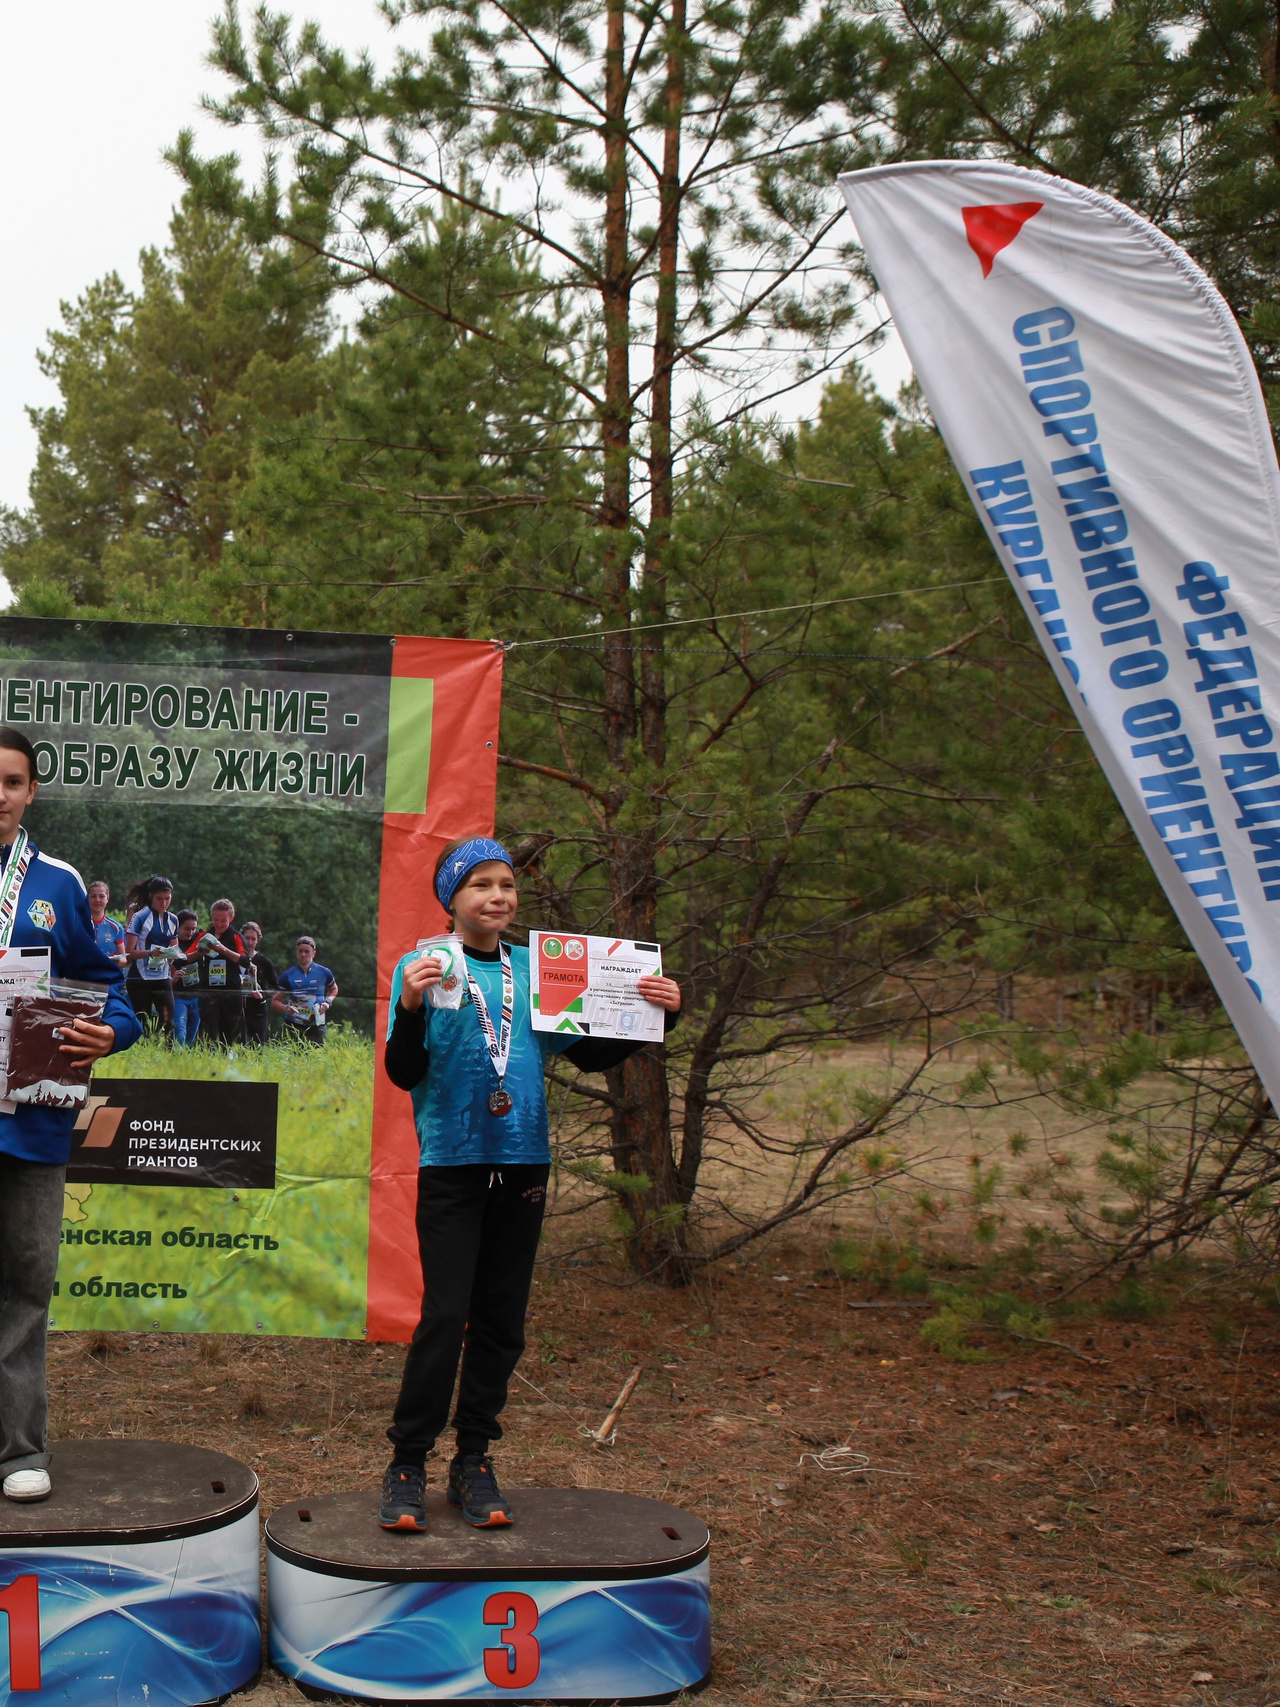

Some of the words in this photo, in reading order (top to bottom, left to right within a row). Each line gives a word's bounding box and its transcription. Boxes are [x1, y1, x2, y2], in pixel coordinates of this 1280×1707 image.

[1013, 307, 1169, 690] СПОРТИВНОГО
[344, 711, 360, 726] -
[1176, 561, 1280, 901] ФЕДЕРАЦИ
[32, 741, 200, 789] ОБРАЗУ
[213, 748, 366, 797] ЖИЗНИ
[543, 972, 585, 983] ГРАМОТА
[601, 965, 642, 973] НАГРАЖДАЕТ
[129, 1120, 175, 1133] ФОНД
[128, 1138, 261, 1152] ПРЕЗИДЕНТСКИХ
[127, 1155, 198, 1168] ГРАНТОВ
[161, 1227, 279, 1250] область
[69, 1276, 188, 1299] область
[482, 1592, 540, 1689] 3
